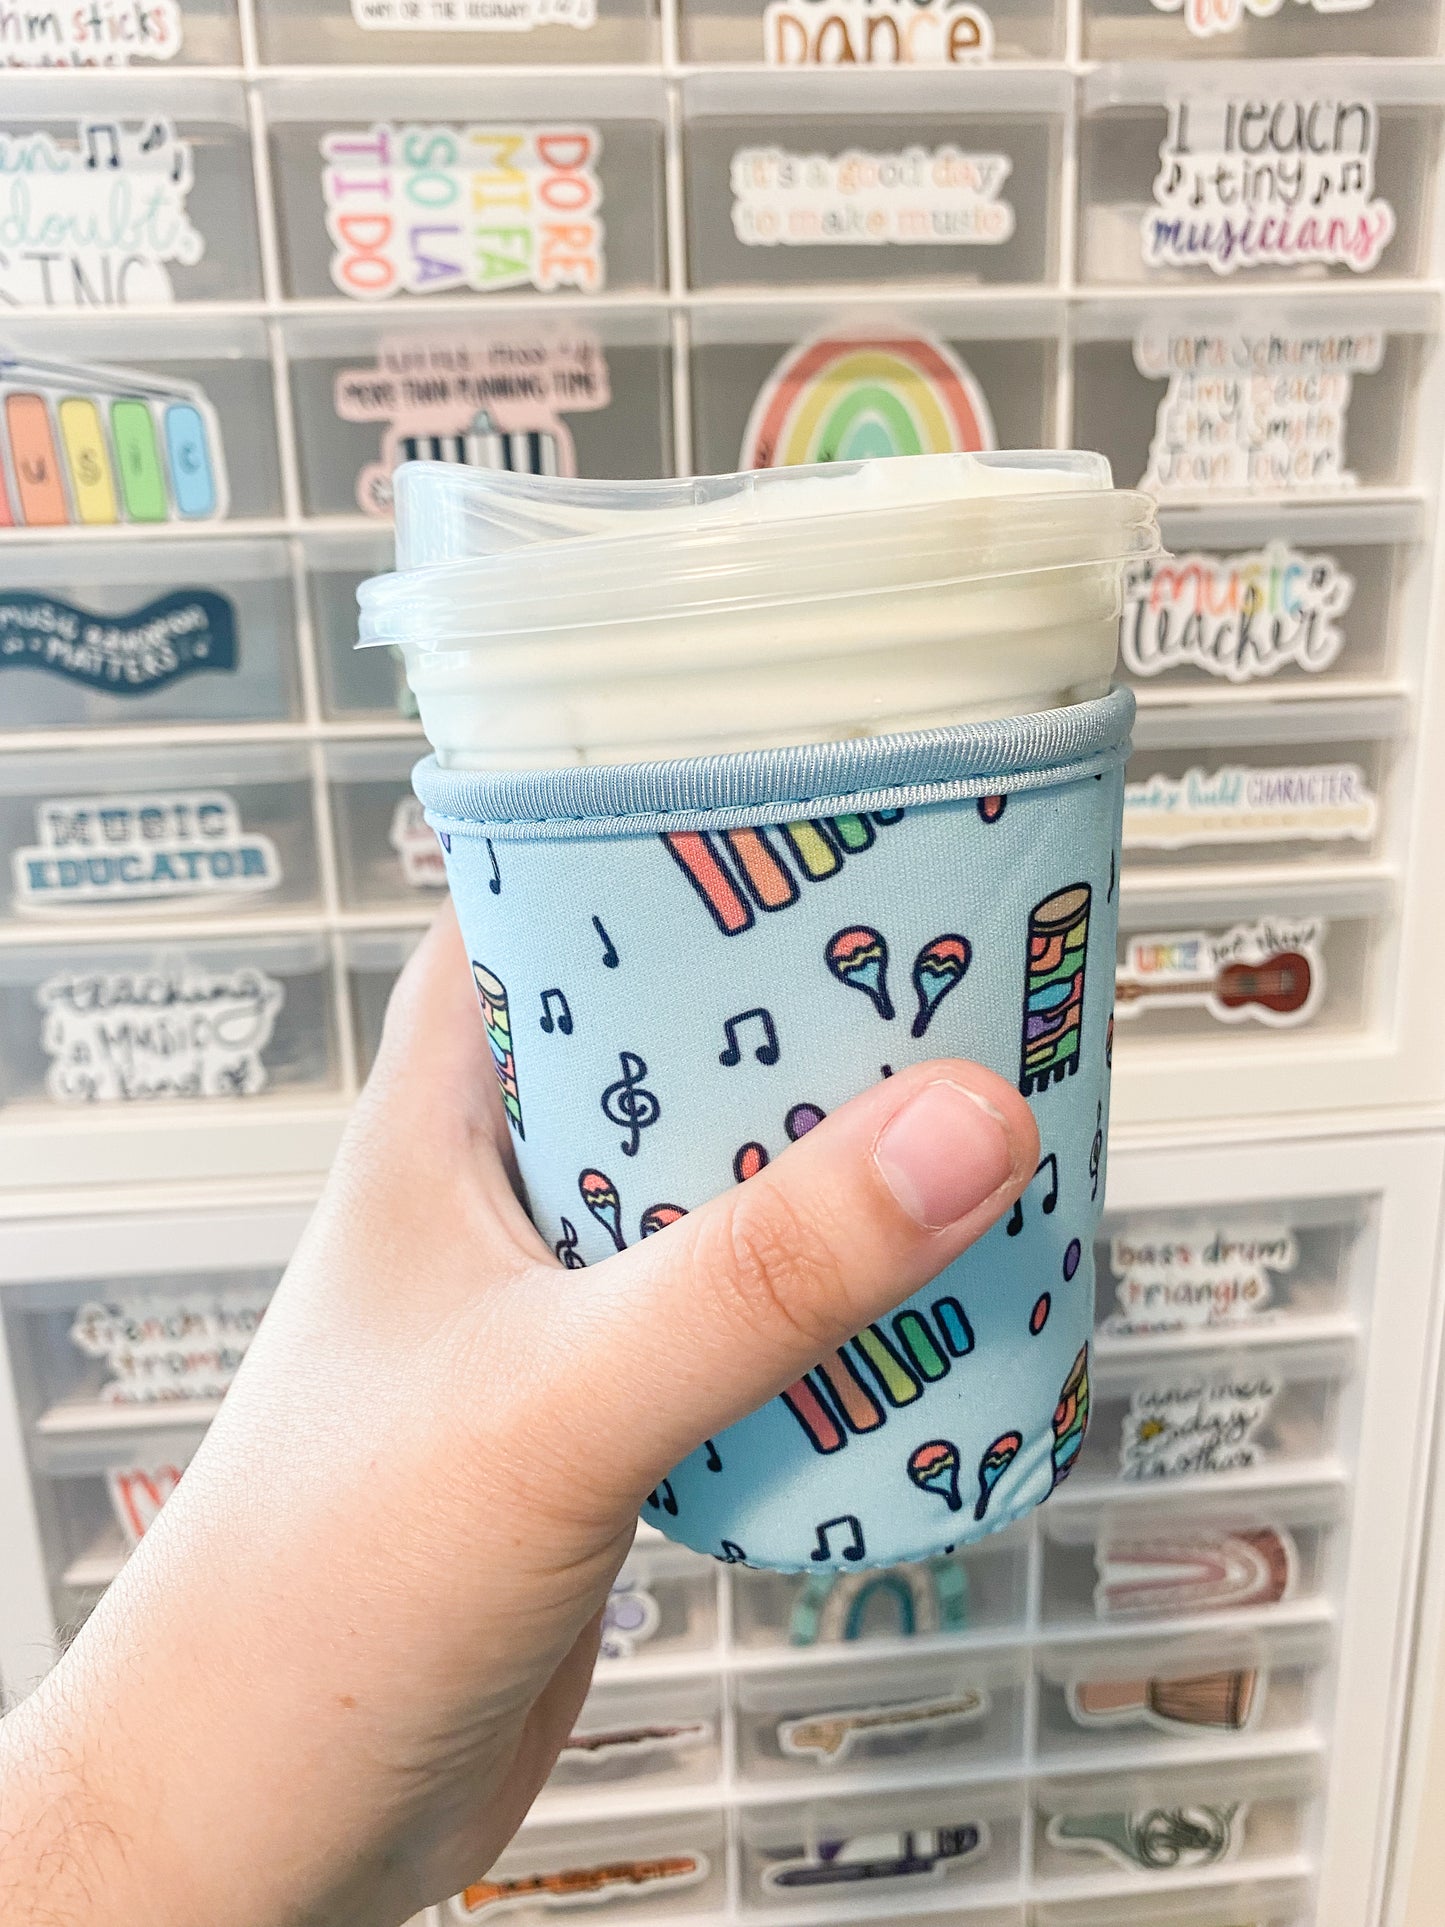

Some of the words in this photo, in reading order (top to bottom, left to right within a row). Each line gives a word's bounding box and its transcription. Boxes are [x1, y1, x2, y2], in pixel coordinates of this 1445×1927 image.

[71, 1, 169, 43] sticks
[403, 132, 459, 210] SO
[536, 134, 593, 211] DO
[1214, 159, 1304, 205] tiny
[338, 213, 396, 290] DO
[410, 225, 463, 284] LA
[476, 226, 533, 282] FA
[539, 223, 597, 285] RE
[1153, 205, 1387, 262] musicians
[1247, 773, 1360, 805] CHARACTER
[47, 804, 227, 846] MUSIC
[26, 848, 268, 890] EDUCATOR
